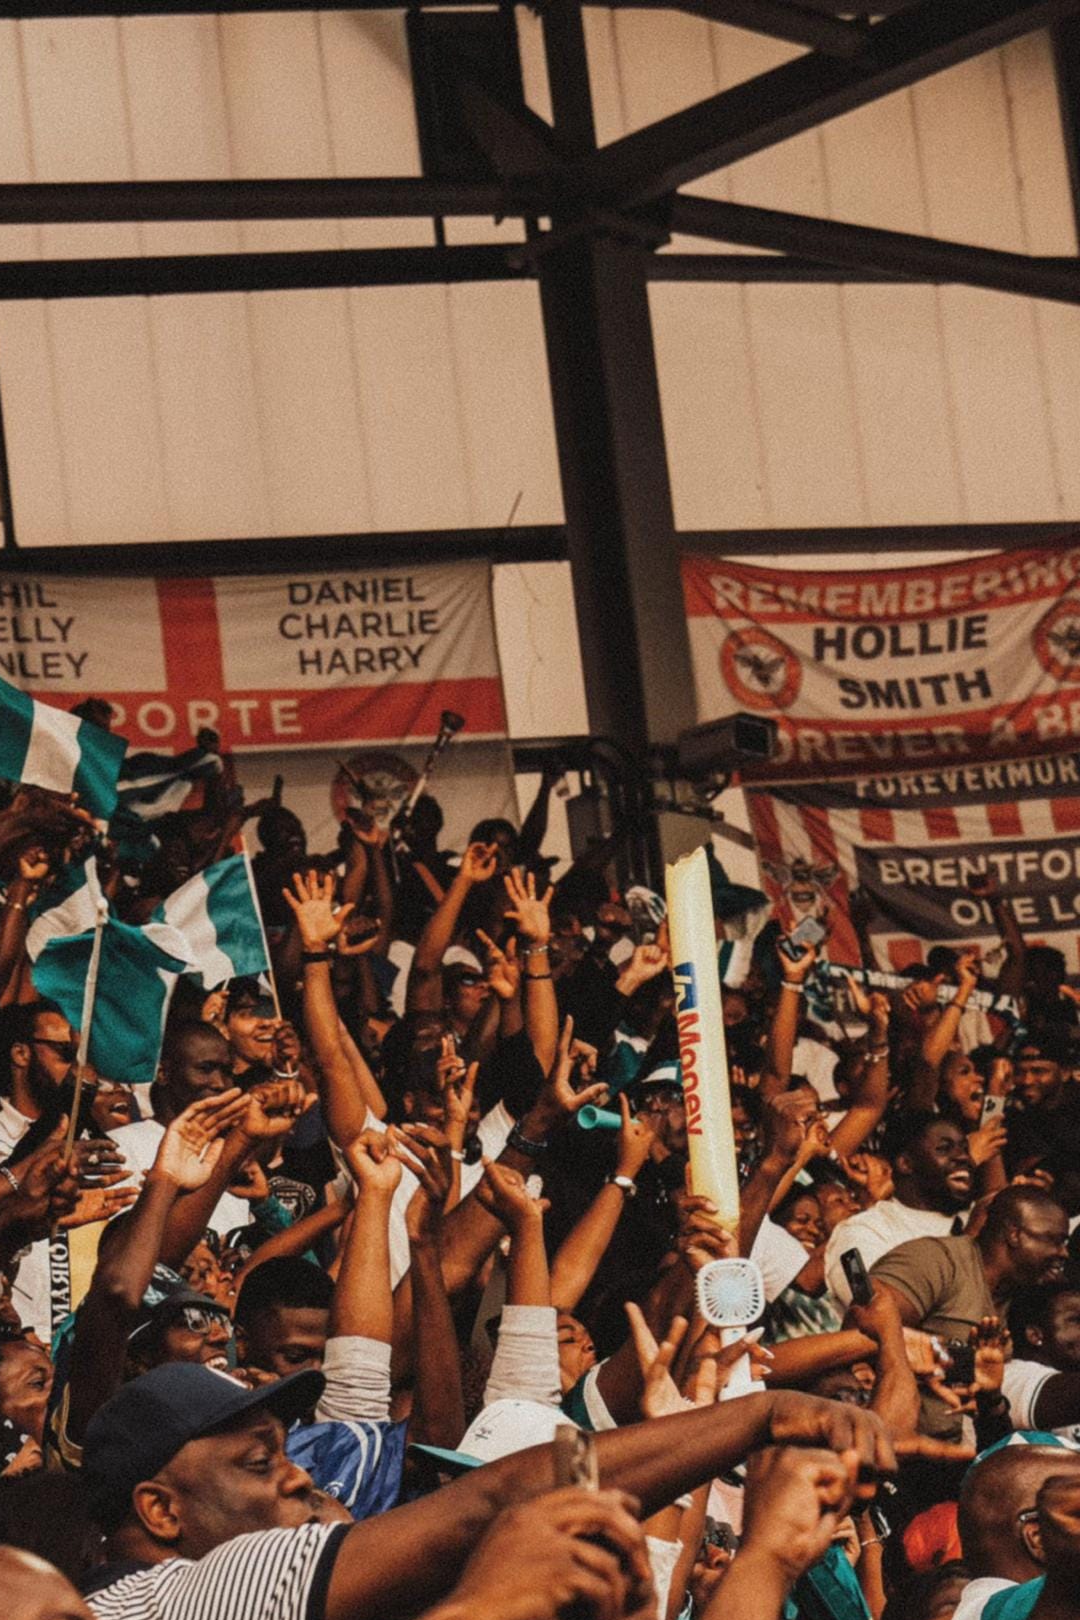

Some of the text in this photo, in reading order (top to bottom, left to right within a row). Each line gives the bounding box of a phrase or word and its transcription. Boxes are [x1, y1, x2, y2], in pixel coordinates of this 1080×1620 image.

[288, 576, 426, 606] DANIEL
[278, 608, 441, 641] CHARLIE
[813, 615, 988, 661] HOLLIE
[298, 645, 424, 676] HARRY
[838, 669, 992, 711] SMITH
[878, 849, 1080, 887] BRENTFO
